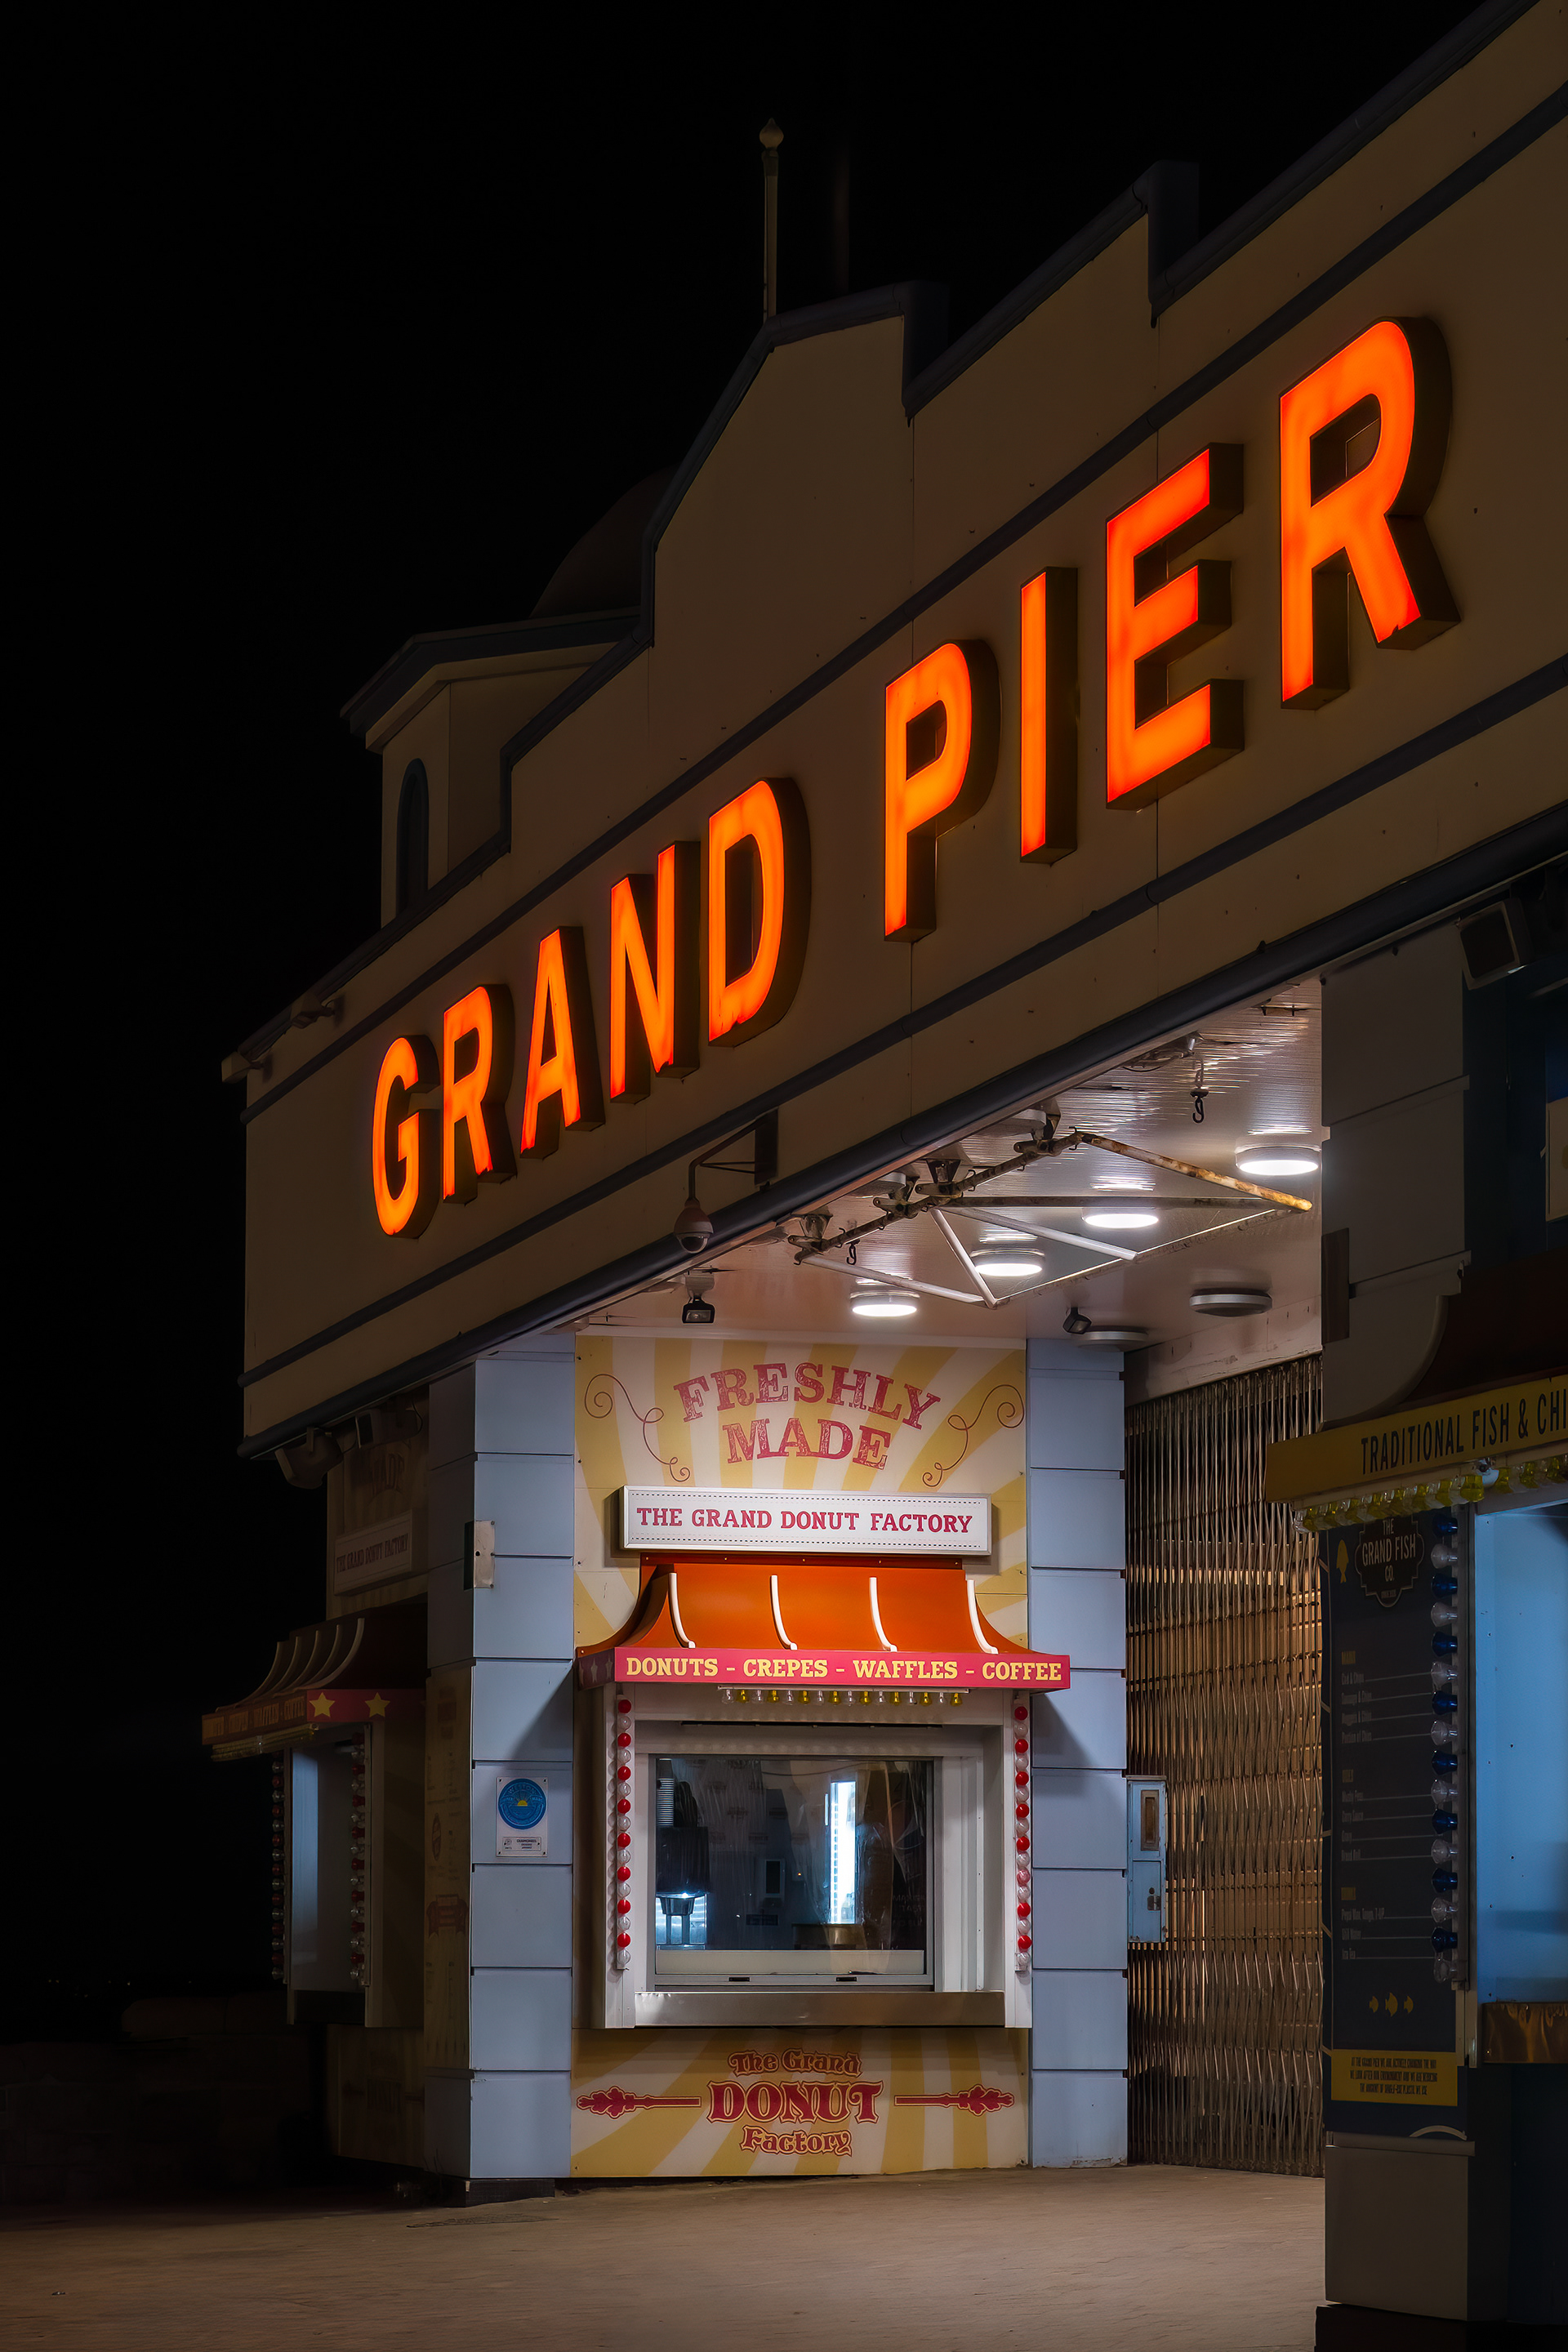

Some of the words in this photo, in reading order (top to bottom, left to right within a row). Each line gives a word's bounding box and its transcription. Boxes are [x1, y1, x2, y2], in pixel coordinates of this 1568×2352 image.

[372, 778, 802, 1238] GRAND
[884, 318, 1444, 939] PIER
[673, 1361, 942, 1430] FRESHLY
[722, 1418, 892, 1471] MADE
[1361, 1414, 1464, 1475] TRADITIONAL
[1472, 1402, 1510, 1450] FISH
[1518, 1398, 1529, 1439] &
[636, 1508, 684, 1527] THE
[691, 1508, 773, 1530] GRAND
[780, 1511, 860, 1532] DONUT
[870, 1512, 973, 1534] FACTORY
[1382, 1518, 1394, 1535] THE
[1362, 1538, 1392, 1566] GRAND
[1395, 1533, 1416, 1561] FISH
[626, 1657, 719, 1678] DONUTS
[742, 1659, 828, 1679] CREPES
[853, 1659, 959, 1681] WAFFLES
[982, 1661, 1062, 1682] COFFEE
[729, 2051, 777, 2078] The
[781, 2047, 864, 2078] Grand
[706, 2080, 884, 2124] DONUT
[740, 2125, 853, 2158] Factory
